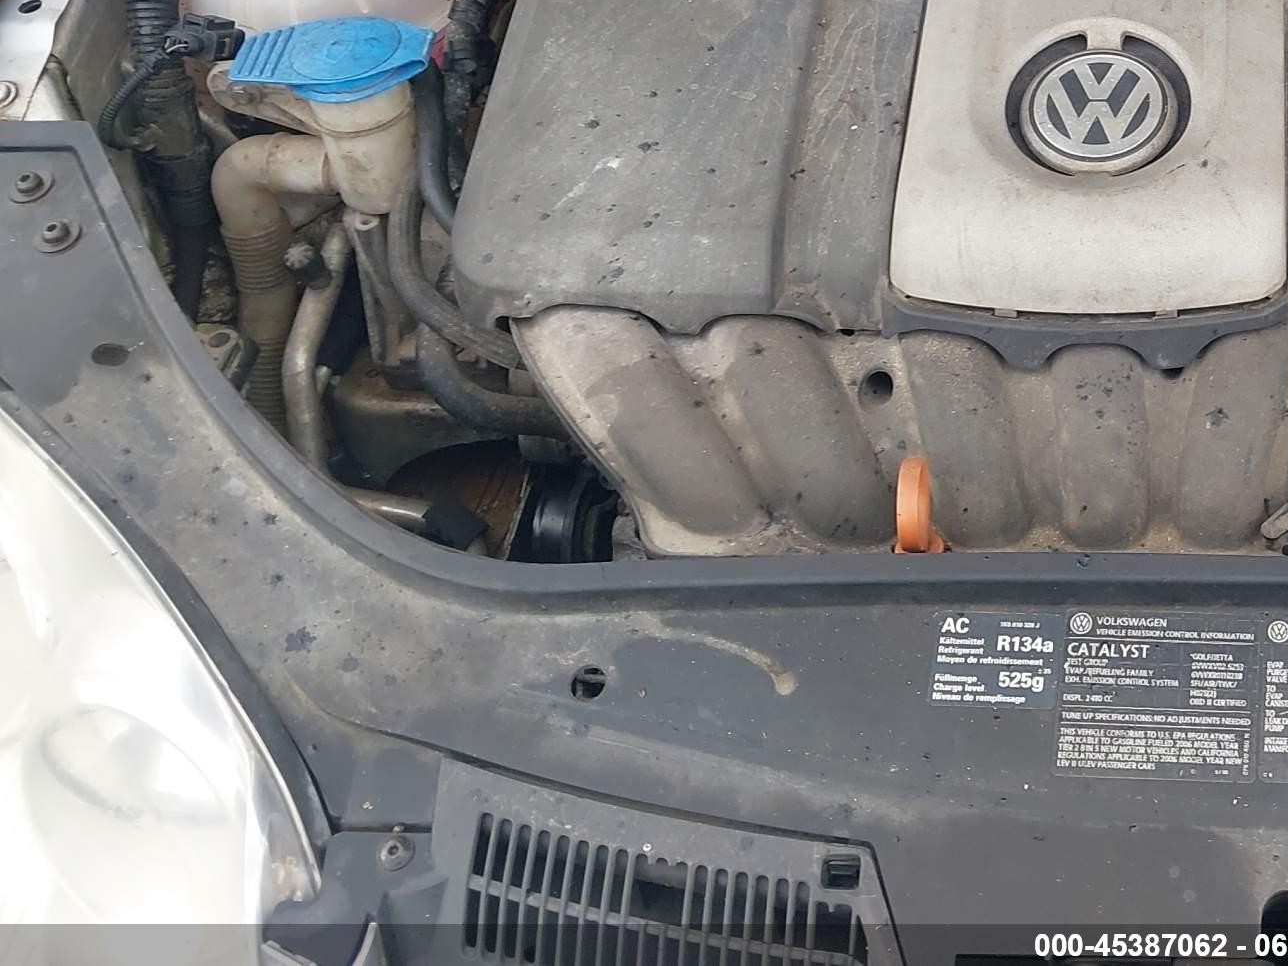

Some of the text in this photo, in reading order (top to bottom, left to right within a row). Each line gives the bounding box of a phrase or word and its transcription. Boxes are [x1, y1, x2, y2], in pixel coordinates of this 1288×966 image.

[1029, 50, 1168, 162] VW
[941, 617, 970, 633] AC
[1096, 616, 1168, 628] VOLKSWAGEN
[1096, 628, 1254, 641] VEHICLE EMISSION CONTROL INFORMATION
[997, 635, 1054, 653] R134a
[938, 646, 984, 655] Refrigerant
[1067, 642, 1150, 658] CATALYST
[937, 655, 965, 664] Moyen
[967, 656, 978, 664] de
[1067, 657, 1109, 666] TEST GROUP
[1126, 669, 1154, 677] FAMILY
[1267, 668, 1288, 676] PURGE
[998, 671, 1044, 693] 525g
[1082, 676, 1115, 684] EMISSION
[1117, 678, 1149, 686] CONTROL
[1151, 679, 1179, 687] SYSTEM
[1266, 675, 1288, 683] VALVE
[933, 683, 985, 692] Charge level
[1265, 685, 1276, 693] TO
[932, 692, 1026, 704] Niveau de remplissage
[1266, 692, 1283, 700] EVAP
[1213, 699, 1247, 707] CERTIFIED
[1265, 709, 1276, 717] TO
[1082, 712, 1094, 720] UP
[1166, 715, 1220, 724] ADJUSTMENTS
[1221, 717, 1251, 726] NEEDED
[1264, 717, 1282, 725] LEAK
[1077, 728, 1105, 736] VEHICLE
[1106, 729, 1145, 738] CONFORMS
[1187, 732, 1236, 741] REGULATIONS
[1264, 725, 1285, 733] PUMP
[1059, 736, 1099, 744] APPLICABLE
[1112, 737, 1146, 745] GASOLINE
[1148, 739, 1174, 747] FUELED
[1193, 741, 1218, 749] MODEL
[1220, 742, 1239, 750] YEAR
[1264, 737, 1288, 745] INTAKE
[1058, 743, 1073, 751] TIER
[1146, 747, 1179, 755] VEHICLES
[1180, 748, 1196, 756] AND
[1197, 749, 1239, 757] CALIFORNIA
[1057, 751, 1105, 760] REGULATIONS
[1107, 753, 1148, 761] APPLICABLE
[1178, 756, 1204, 764] MODEL
[1225, 757, 1243, 765] NEW
[1056, 759, 1071, 767] LEV
[1097, 761, 1137, 769] PASSENGER
[1137, 762, 1156, 770] CARS
